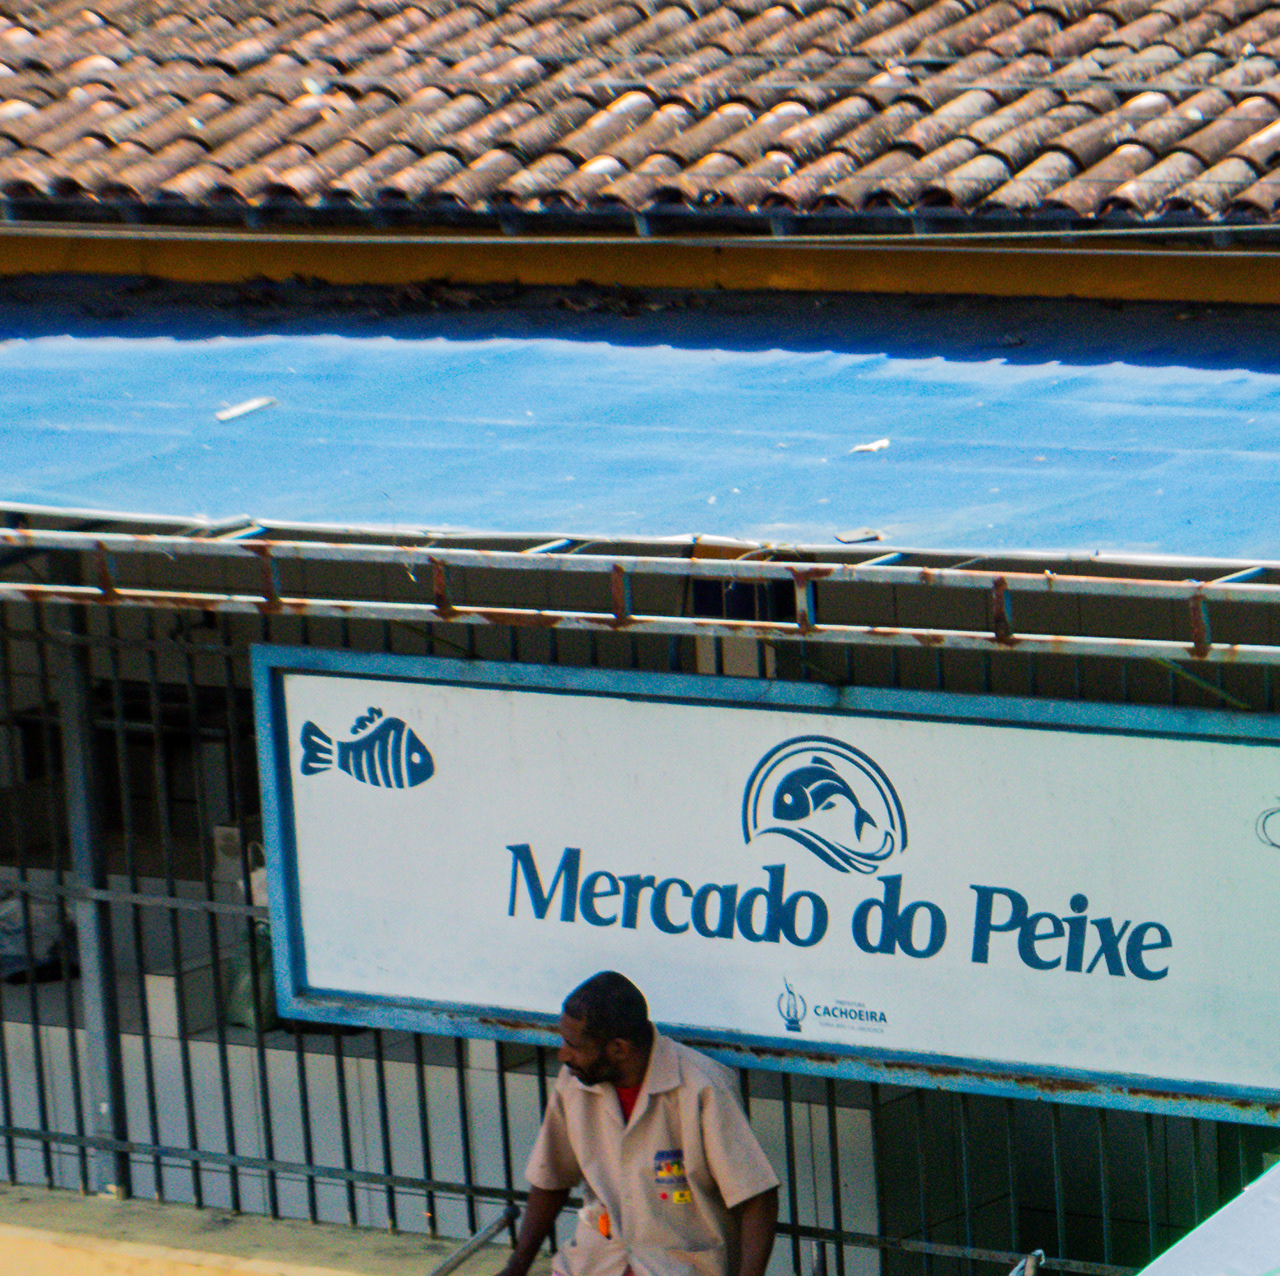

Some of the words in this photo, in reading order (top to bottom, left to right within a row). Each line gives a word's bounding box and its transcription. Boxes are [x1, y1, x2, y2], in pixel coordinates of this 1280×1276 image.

[506, 843, 828, 948] Mercado
[851, 874, 947, 958] do
[969, 884, 1173, 981] Peixe
[814, 1005, 887, 1023] CACHOEIRA
